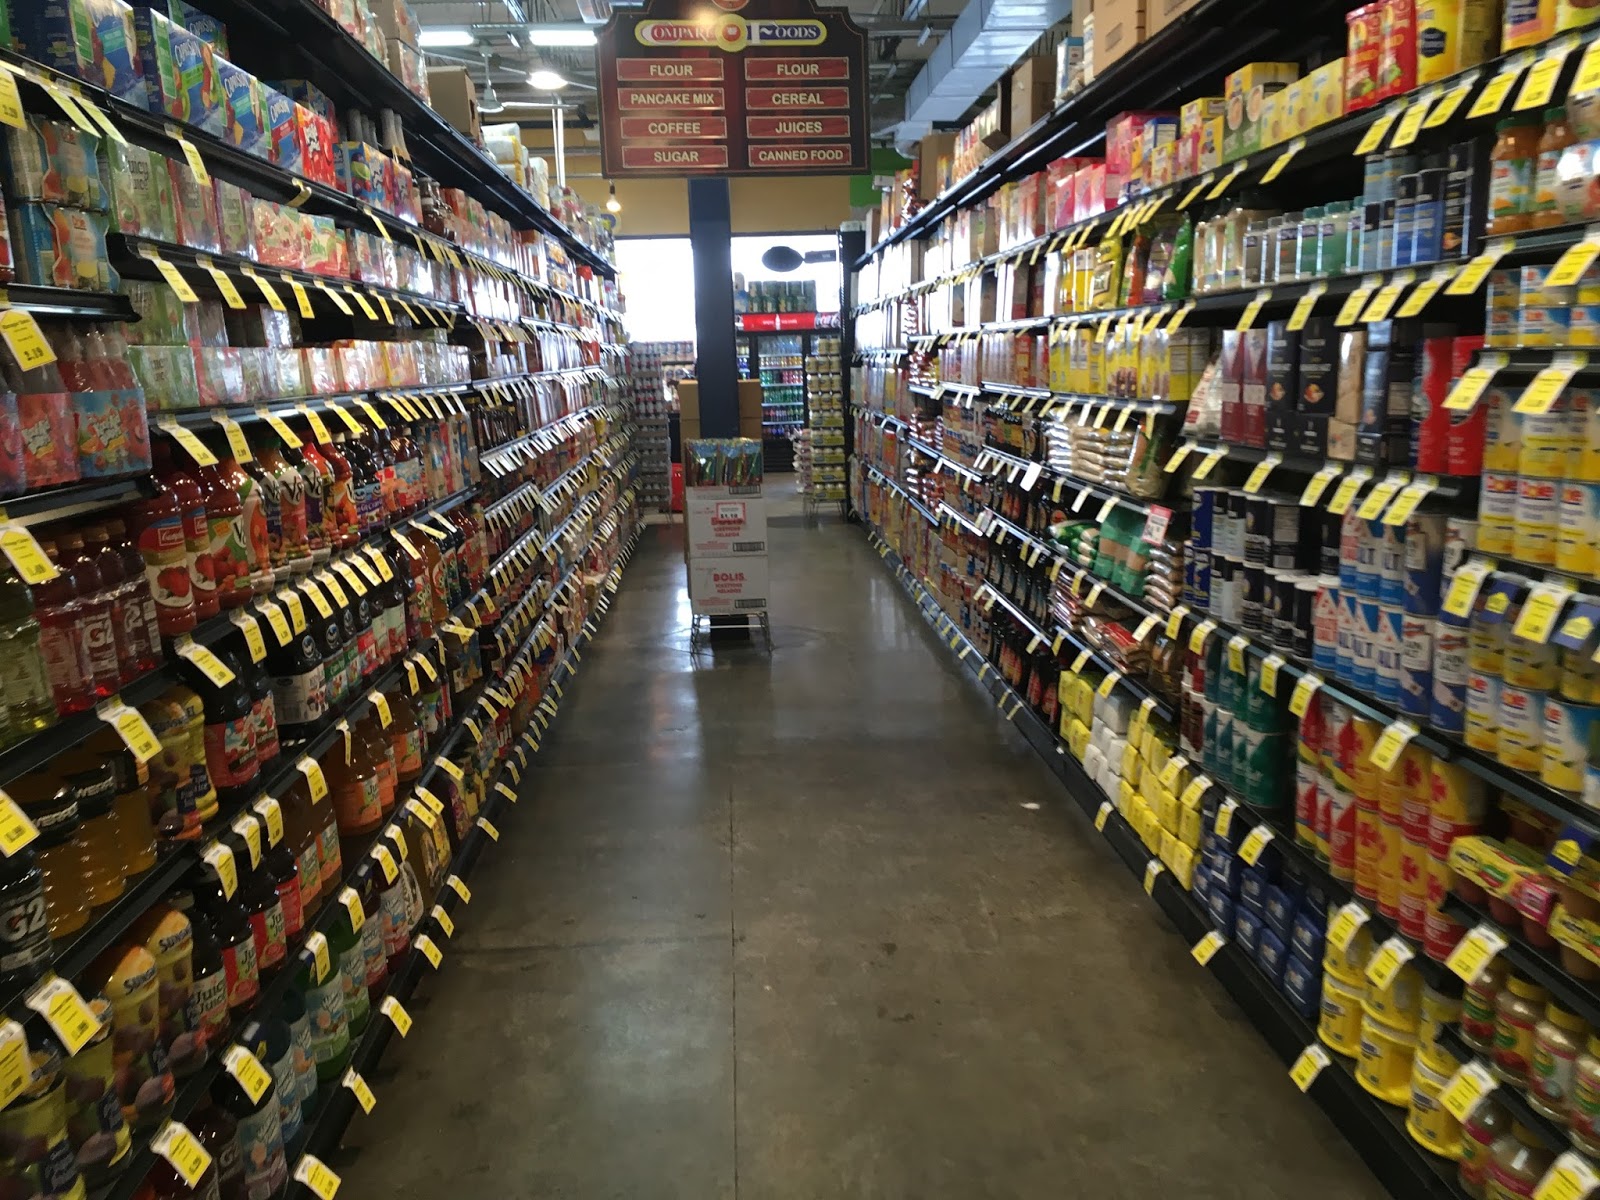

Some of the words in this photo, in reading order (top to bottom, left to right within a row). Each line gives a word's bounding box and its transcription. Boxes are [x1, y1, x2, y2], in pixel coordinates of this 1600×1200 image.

[650, 65, 693, 76] FLOUR
[777, 64, 819, 75] FLOUR
[631, 93, 690, 105] PANCAKE
[693, 93, 714, 105] MIX
[772, 93, 824, 105] CEREAL
[648, 122, 700, 134] COFFEE
[775, 121, 822, 133] JUICES
[654, 151, 699, 162] SUGAR
[758, 150, 808, 161] CANNED
[810, 149, 843, 161] FOOD
